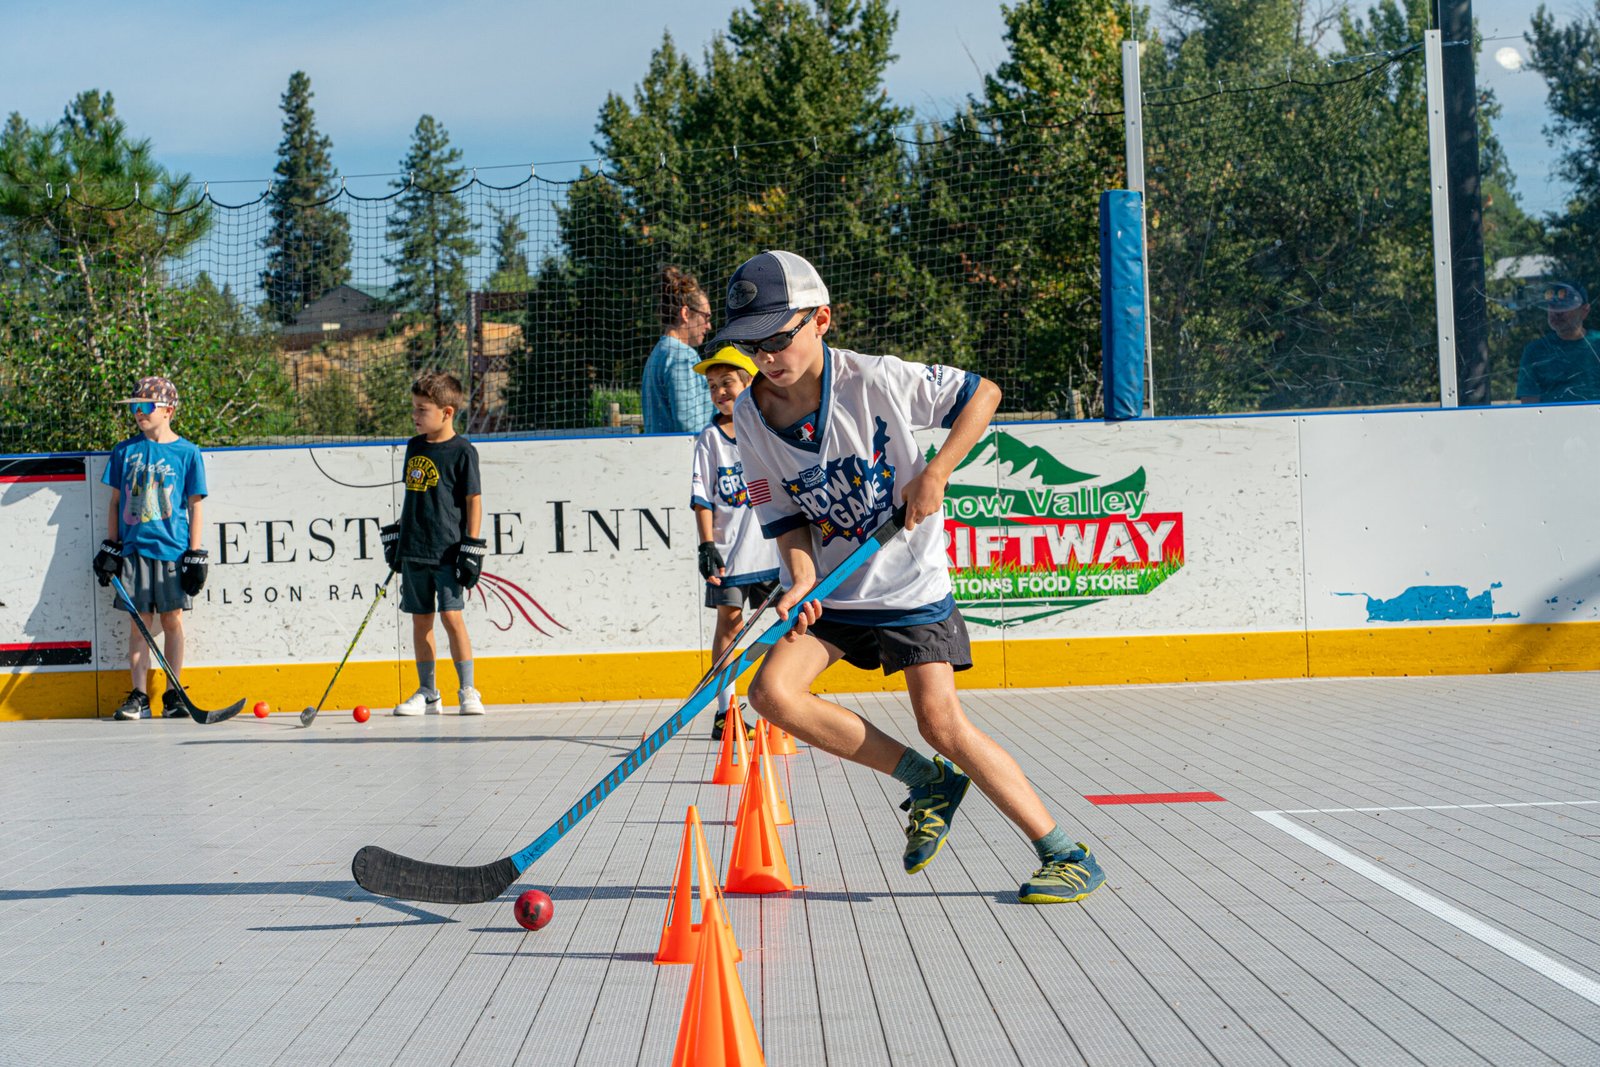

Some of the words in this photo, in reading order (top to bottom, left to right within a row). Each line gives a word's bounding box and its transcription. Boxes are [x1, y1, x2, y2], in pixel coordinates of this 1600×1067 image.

[126, 453, 176, 480] Fender
[719, 474, 743, 495] GR
[829, 478, 888, 529] GAME
[943, 494, 1014, 519] now
[1025, 485, 1149, 520] Valley
[207, 585, 302, 604] ILSON
[329, 583, 404, 600] RAN
[1018, 576, 1071, 593] FOOD
[1076, 573, 1139, 592] STORE
